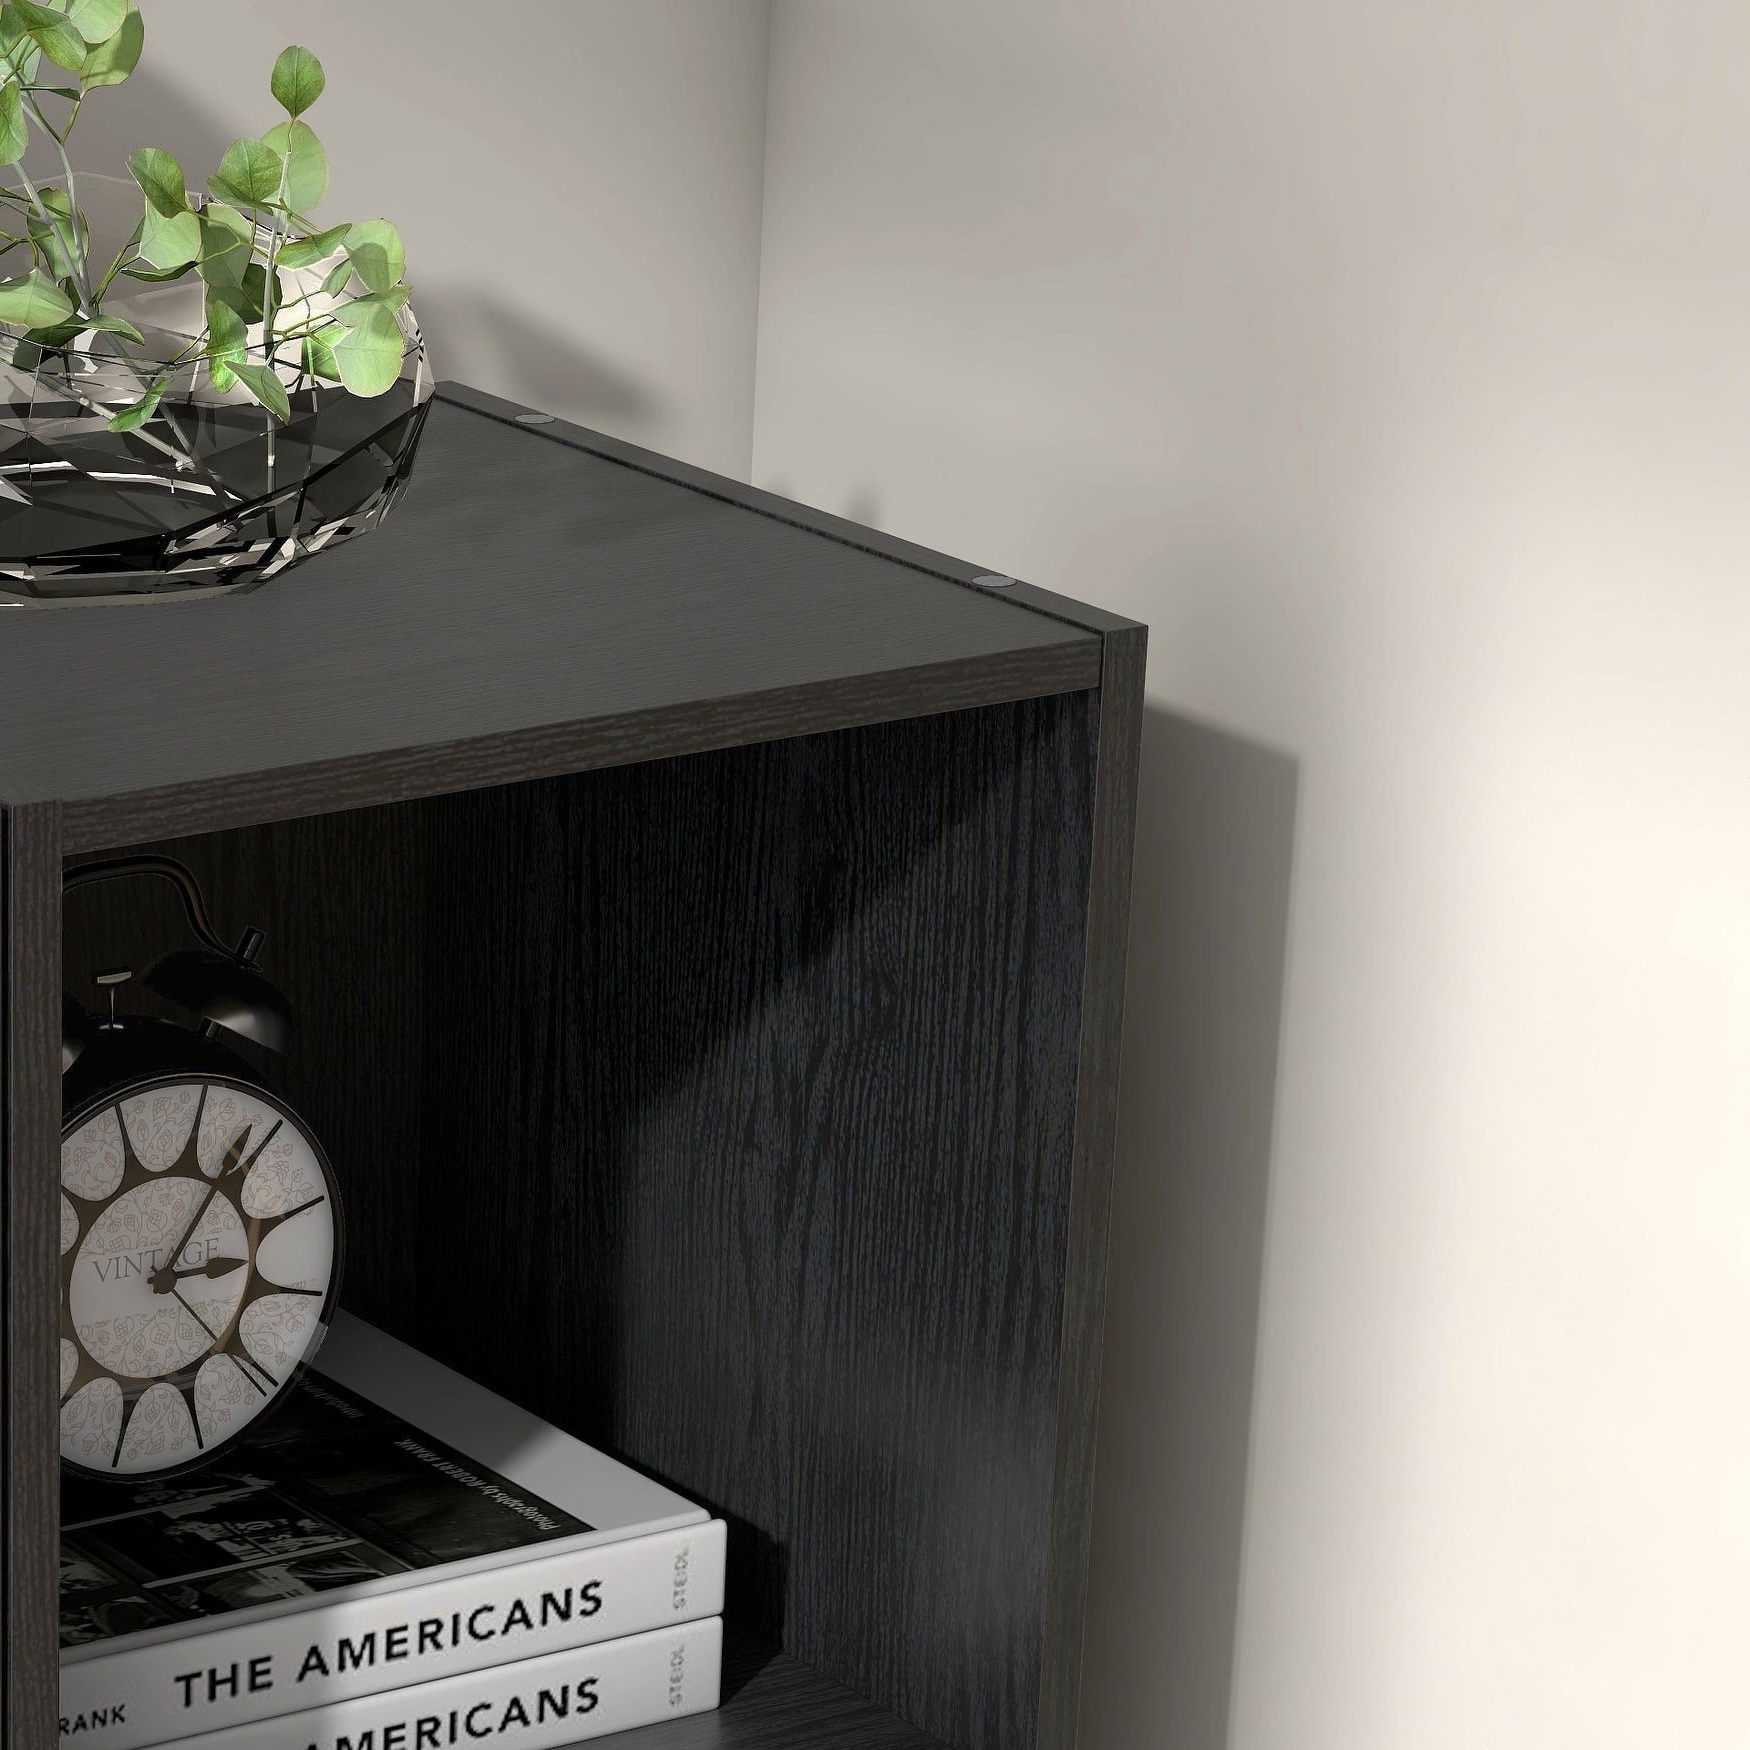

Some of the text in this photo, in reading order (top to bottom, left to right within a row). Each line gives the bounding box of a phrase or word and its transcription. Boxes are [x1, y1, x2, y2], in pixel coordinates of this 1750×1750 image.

[393, 1438, 443, 1464] FRANK
[432, 1460, 487, 1488] ROBERT
[492, 1487, 561, 1531] Photographs
[174, 1579, 604, 1709] THE AMERICANS
